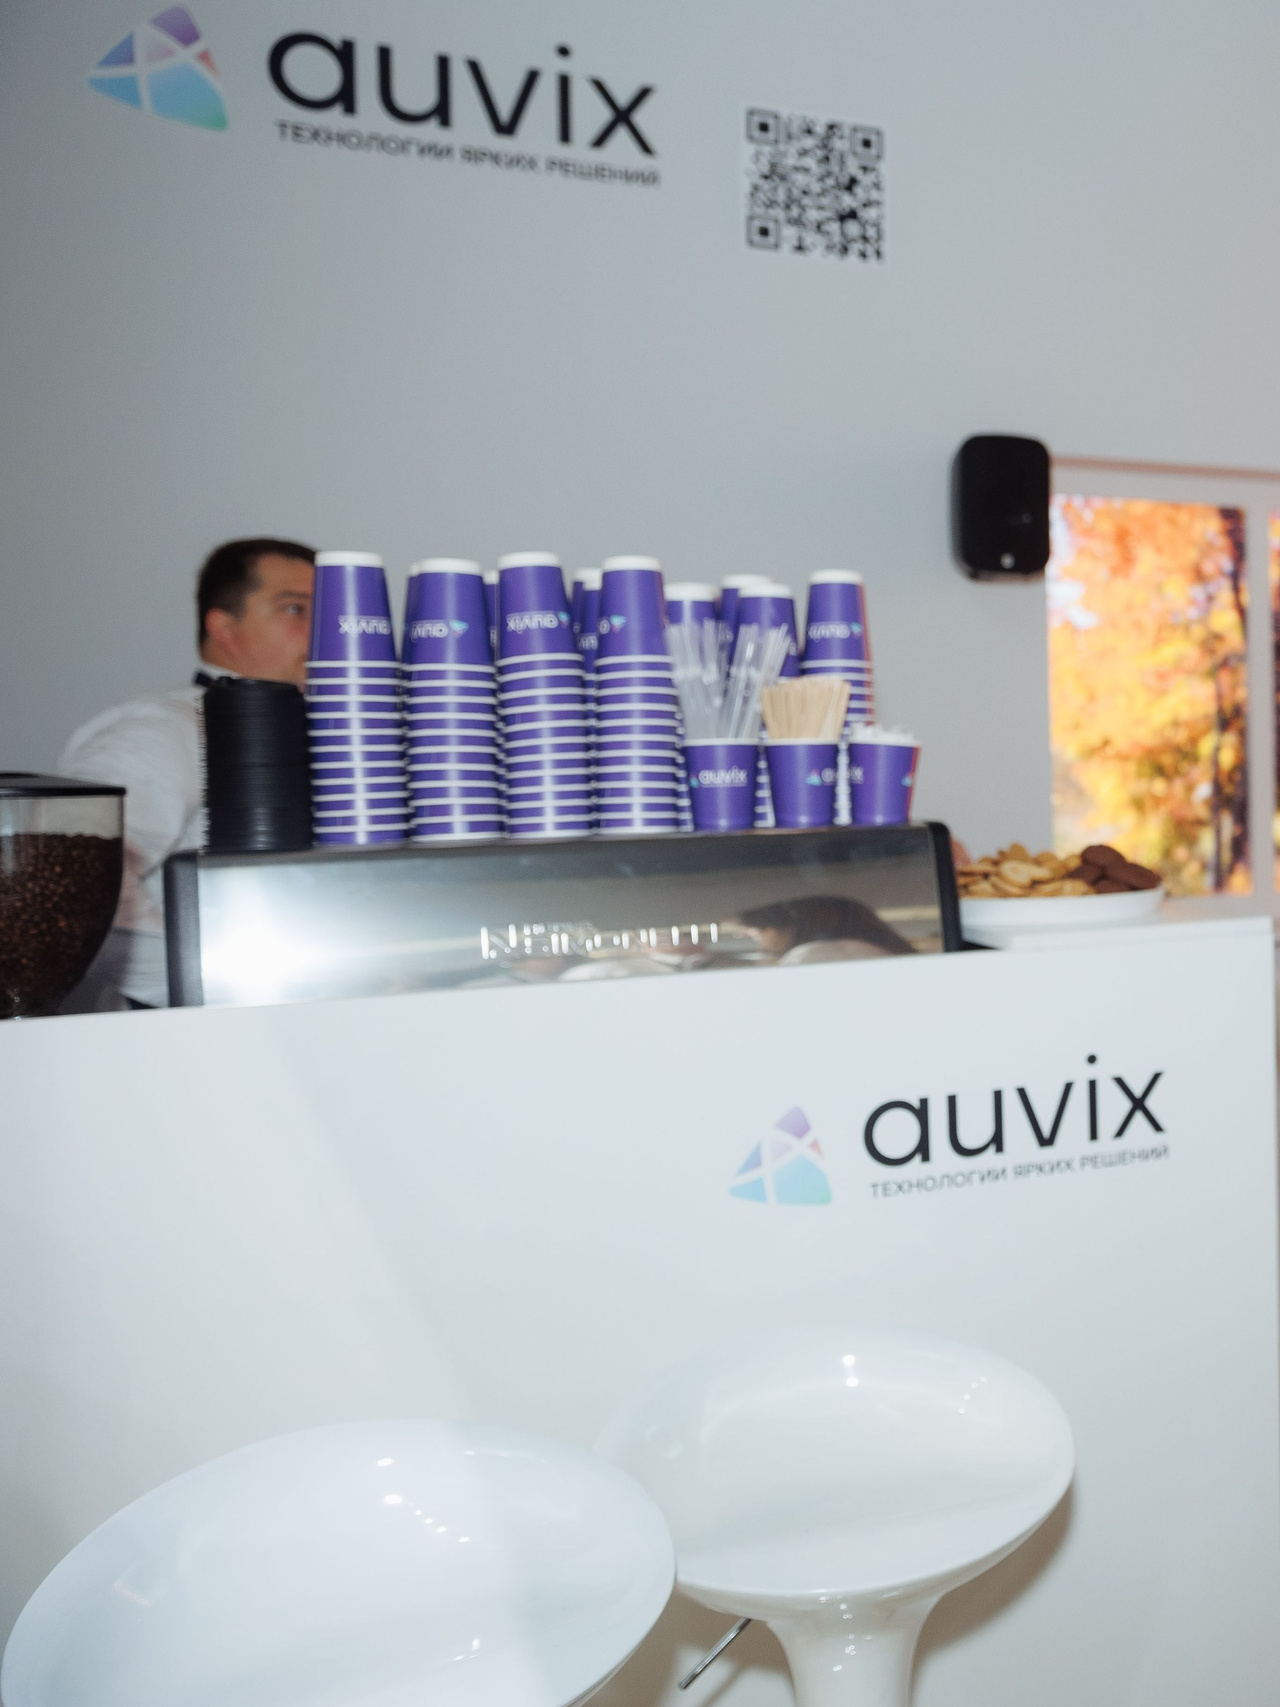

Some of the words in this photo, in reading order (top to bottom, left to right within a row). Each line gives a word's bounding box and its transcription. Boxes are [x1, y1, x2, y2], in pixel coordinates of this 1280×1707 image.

[267, 31, 655, 156] auvix
[274, 119, 453, 159] ТЕХНОЛОГИИ
[460, 147, 540, 173] ЯРКИХ
[544, 157, 660, 187] РЕШЕНИЙ
[699, 765, 748, 784] auvix
[863, 1054, 1165, 1167] auvix
[870, 1166, 1009, 1199] ТЕХНОЛОГИИ
[1012, 1159, 1075, 1180] ЯРКИХ
[1080, 1144, 1169, 1170] РЕШЕНИЙ
